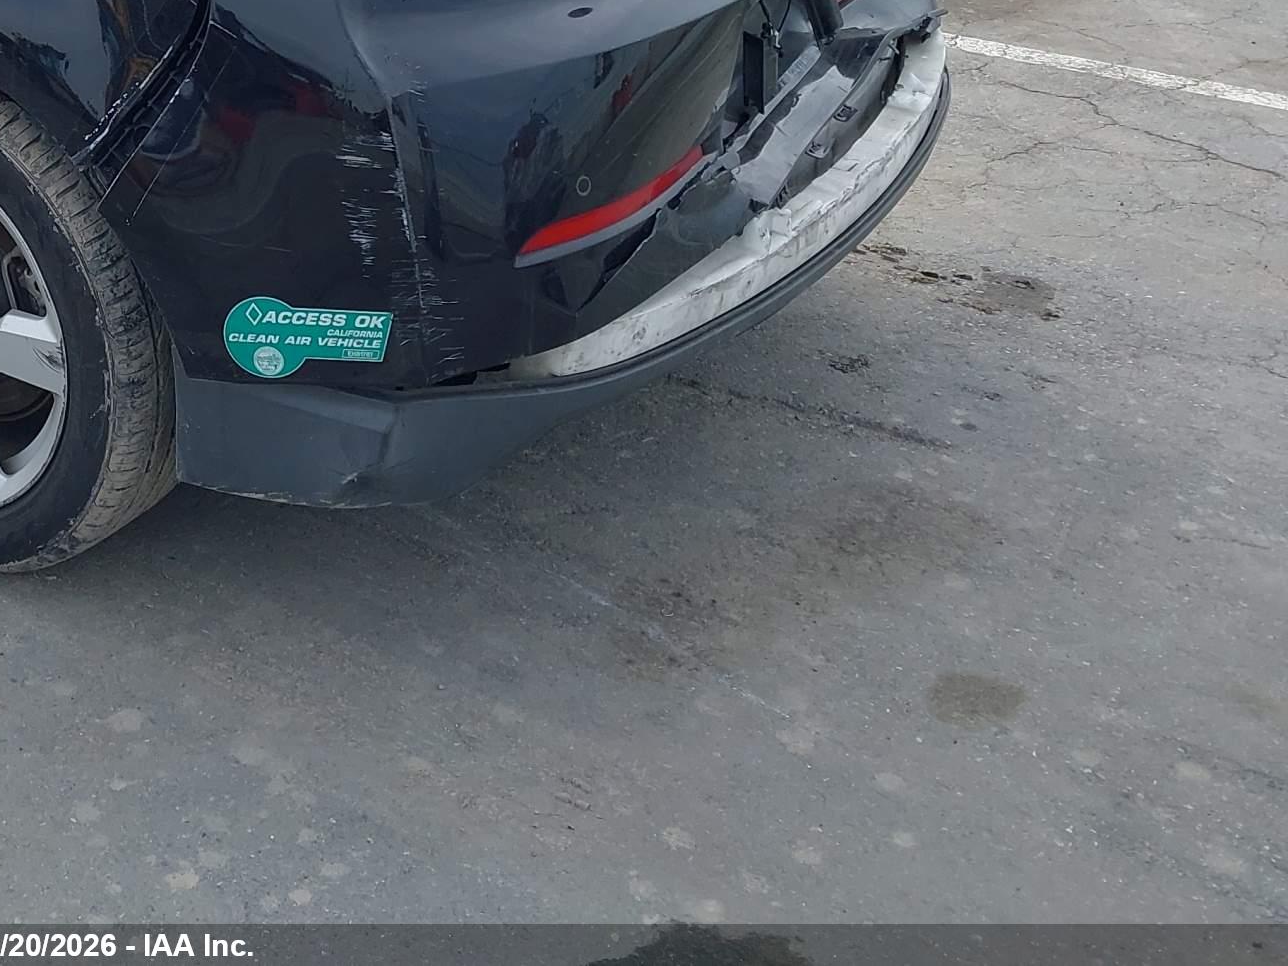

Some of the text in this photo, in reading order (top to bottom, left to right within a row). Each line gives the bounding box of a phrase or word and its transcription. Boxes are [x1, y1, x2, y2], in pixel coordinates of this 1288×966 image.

[262, 310, 387, 329] ACCESS OK
[229, 333, 381, 348] CLEAN AIR VEHICLE
[327, 328, 383, 339] CALIFORNIA
